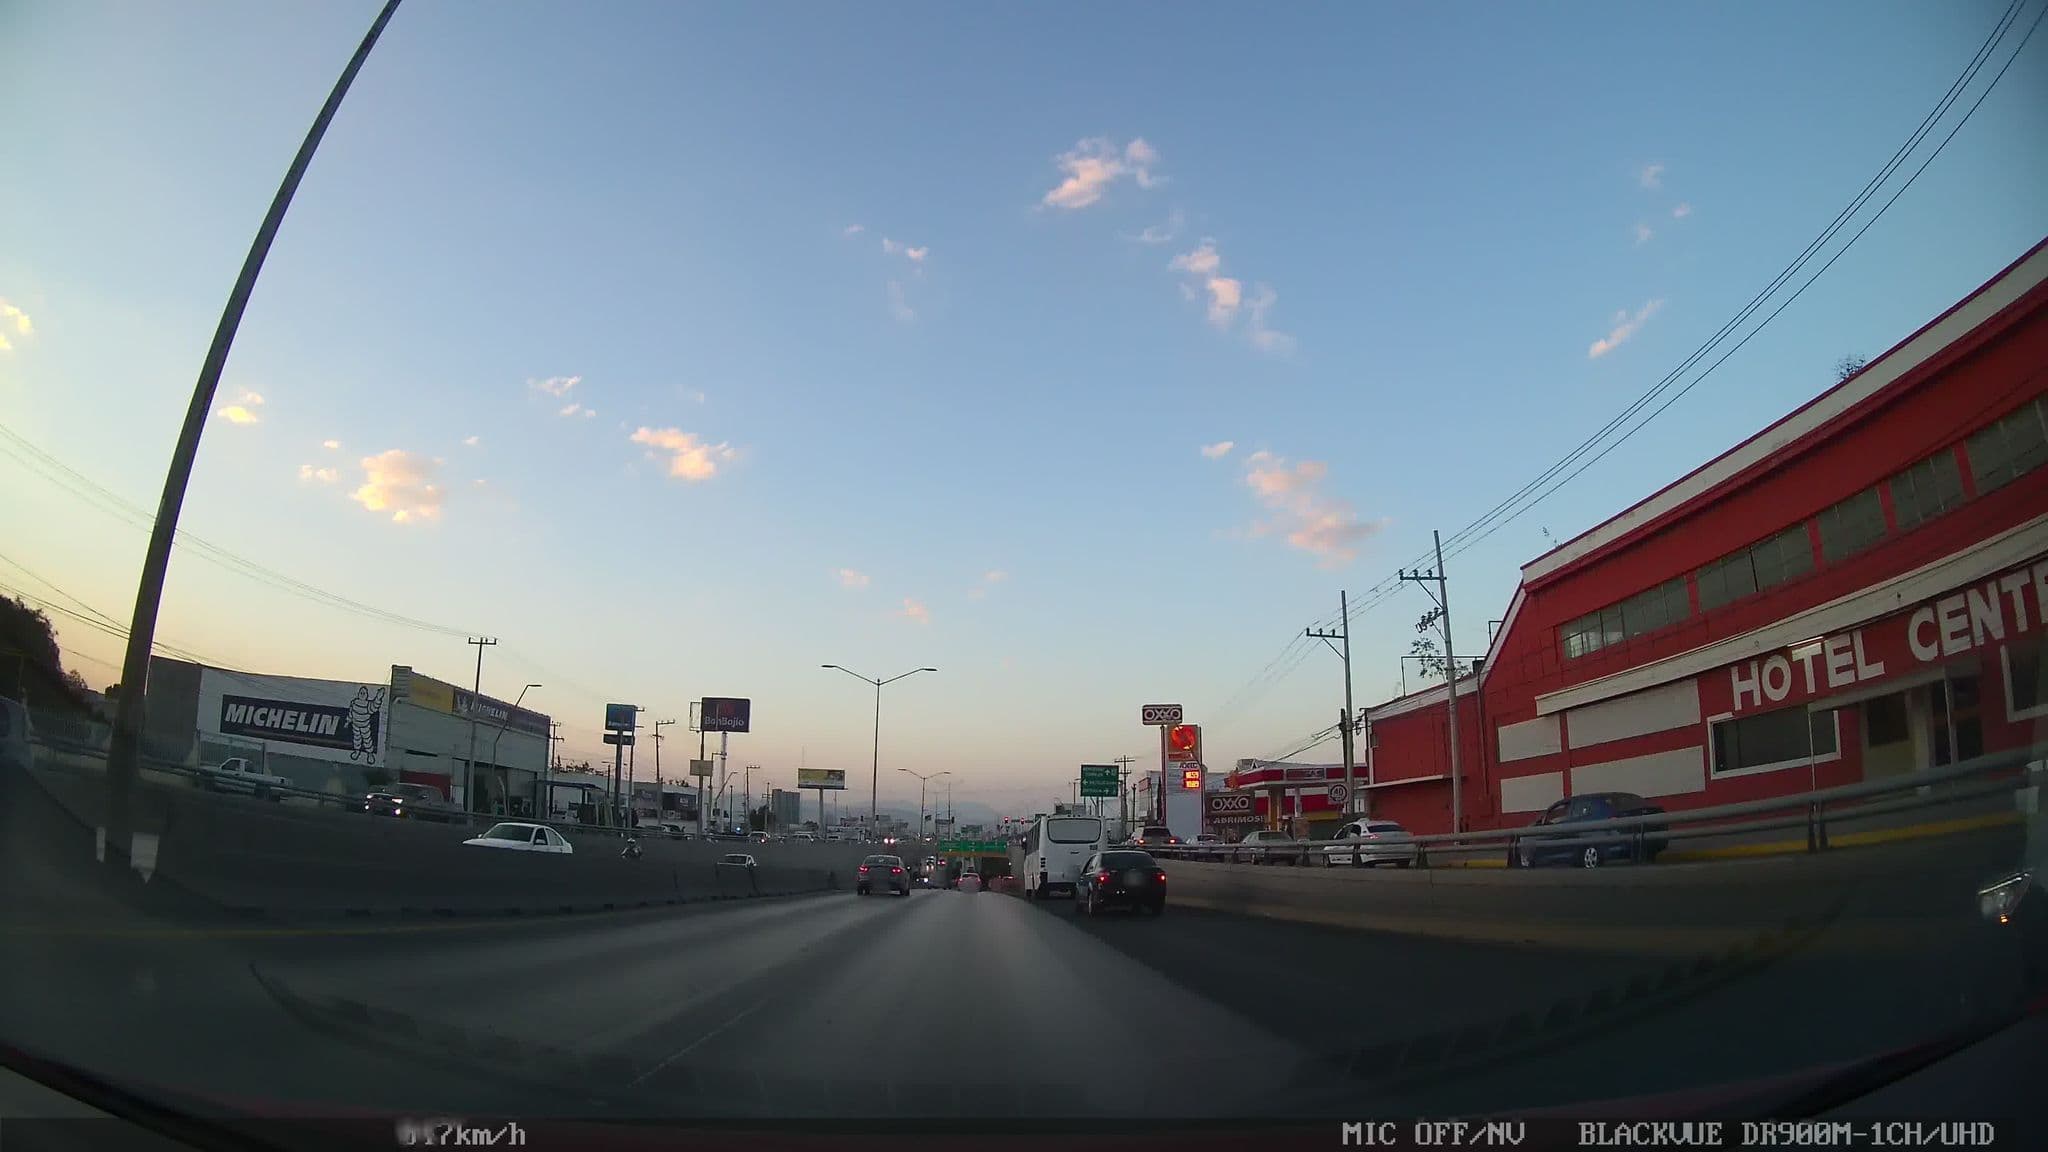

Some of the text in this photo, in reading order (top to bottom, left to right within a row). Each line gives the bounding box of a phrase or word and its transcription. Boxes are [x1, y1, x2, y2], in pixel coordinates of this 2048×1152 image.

[1730, 630, 1885, 711] HOTEL
[225, 703, 341, 736] MICHELIN
[1144, 708, 1181, 720] OXXO
[1212, 796, 1249, 811] OXXO
